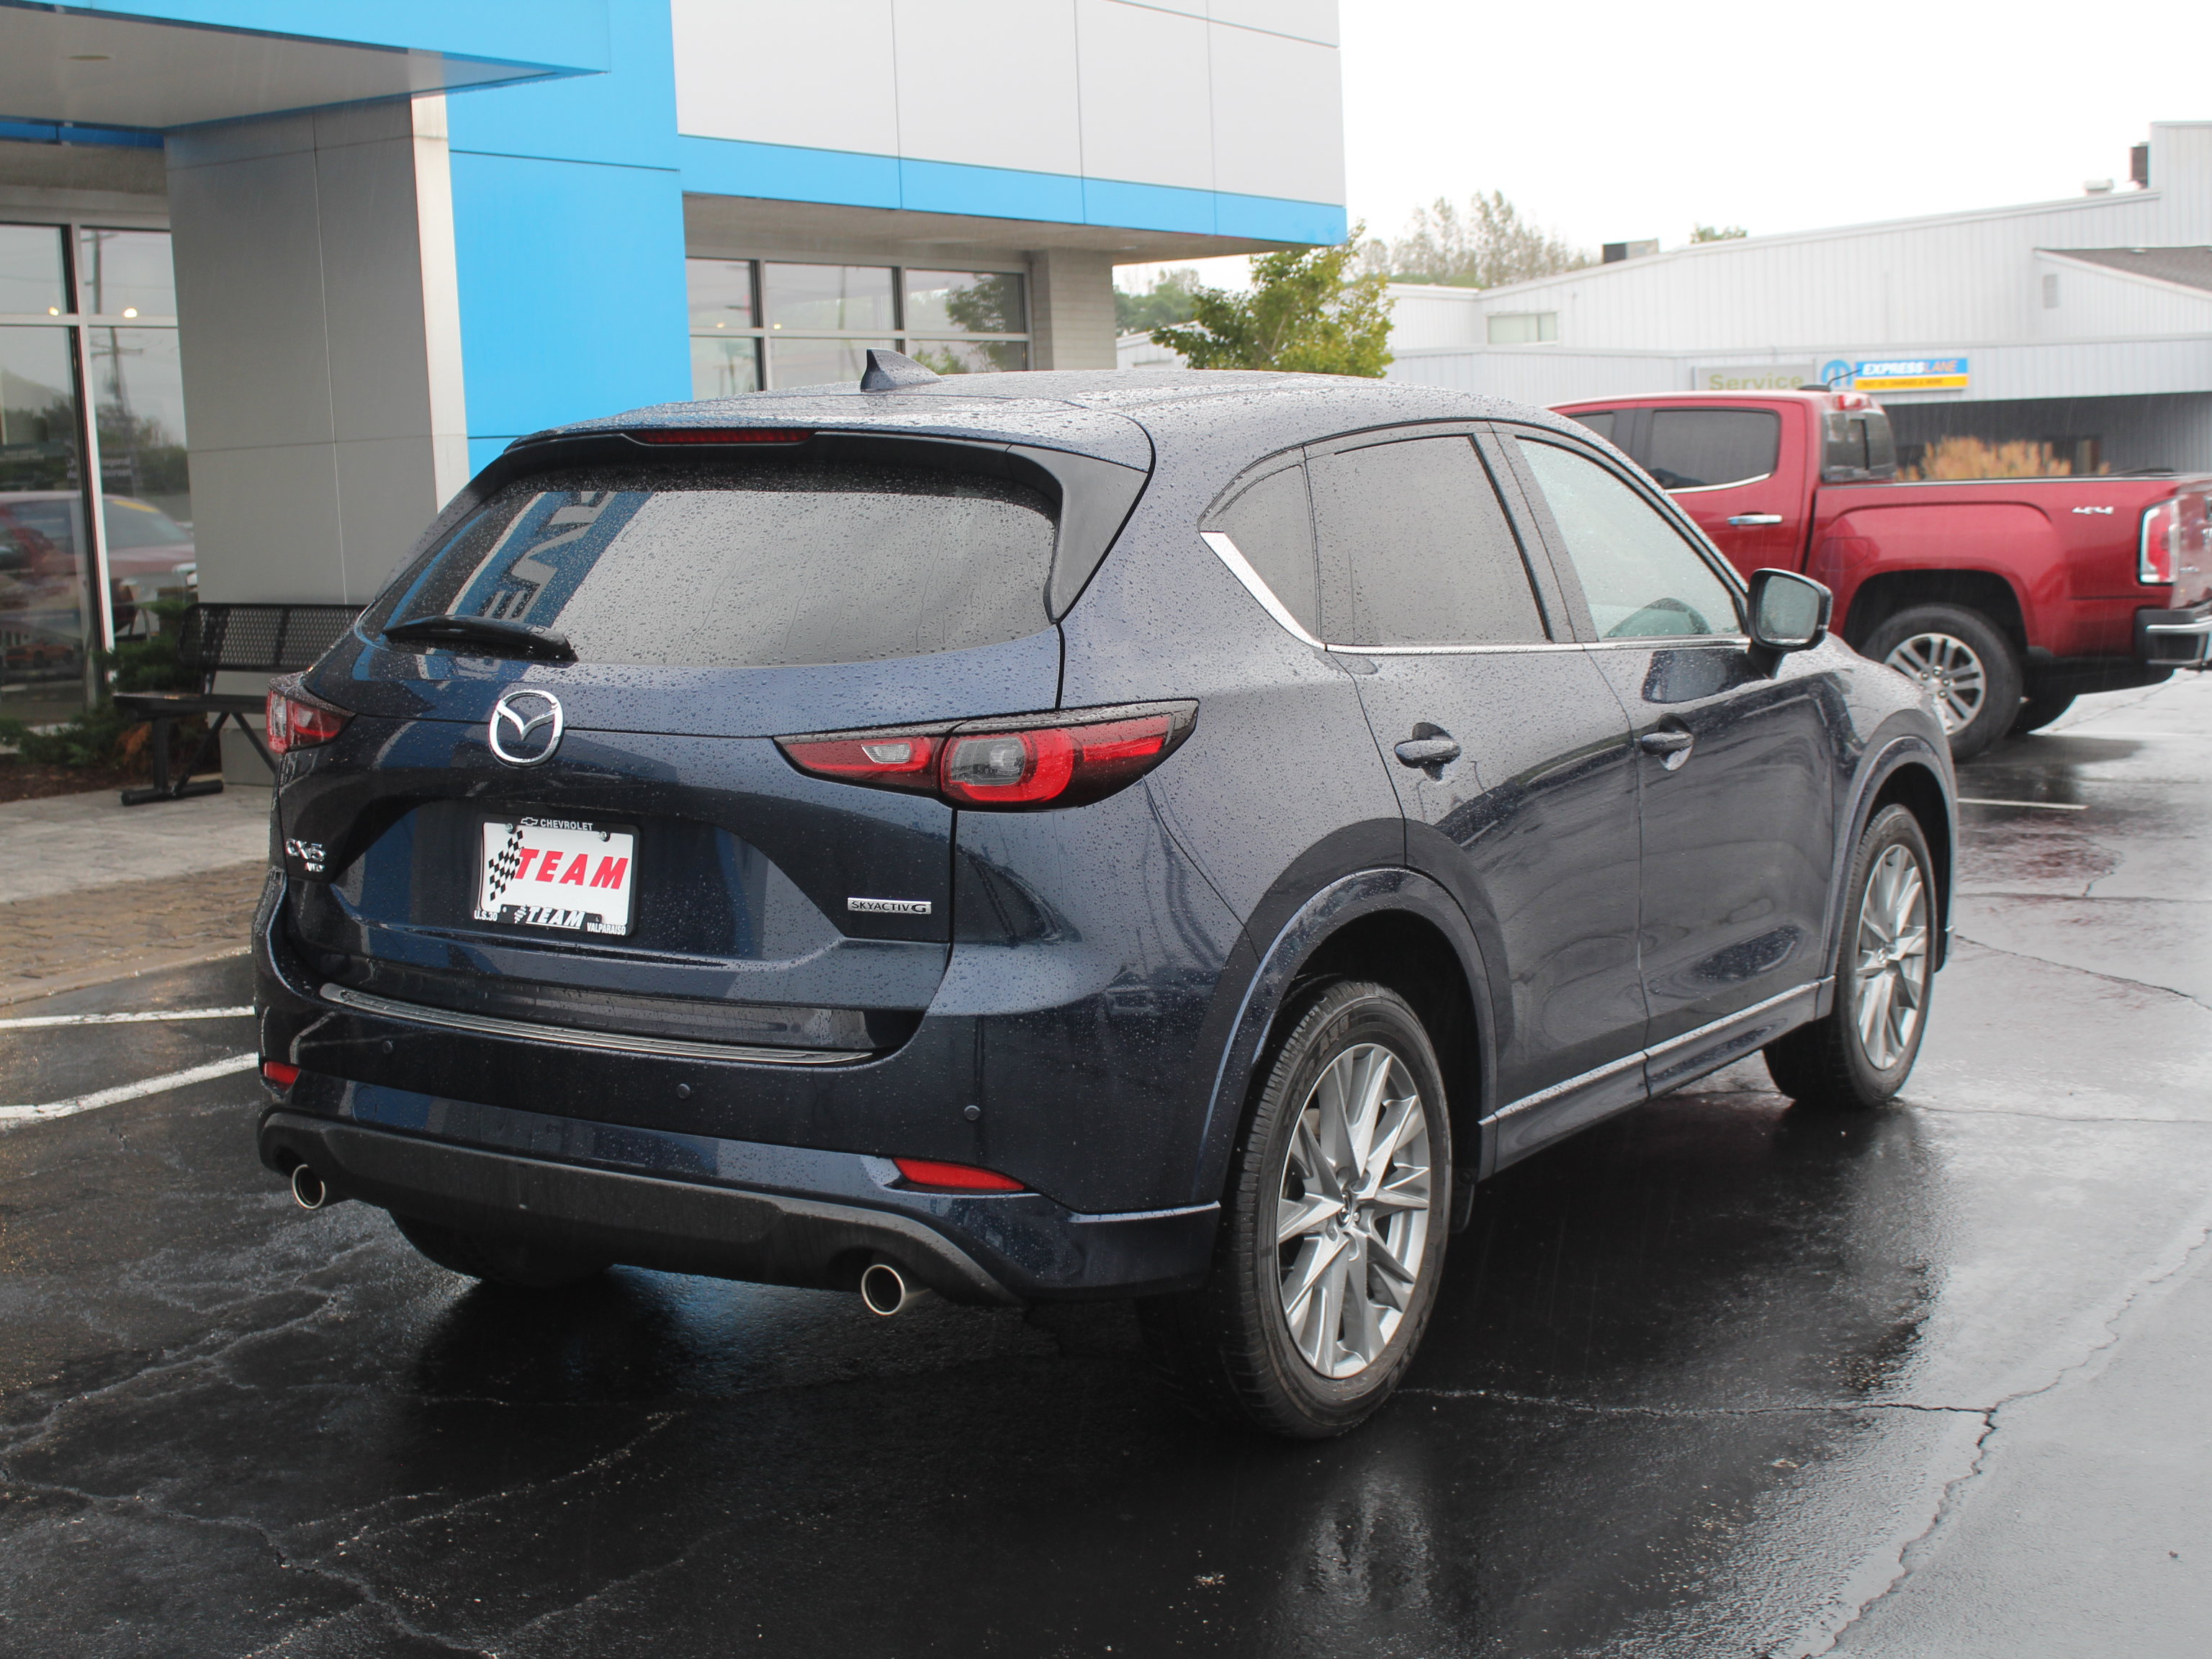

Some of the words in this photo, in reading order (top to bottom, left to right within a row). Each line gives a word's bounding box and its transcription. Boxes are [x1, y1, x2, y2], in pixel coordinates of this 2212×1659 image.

[1709, 372, 1804, 390] Service
[540, 819, 593, 831] CHEVROLET
[515, 848, 629, 890] TEAM
[526, 906, 587, 927] TEAM
[587, 922, 626, 936] VALPARAISO
